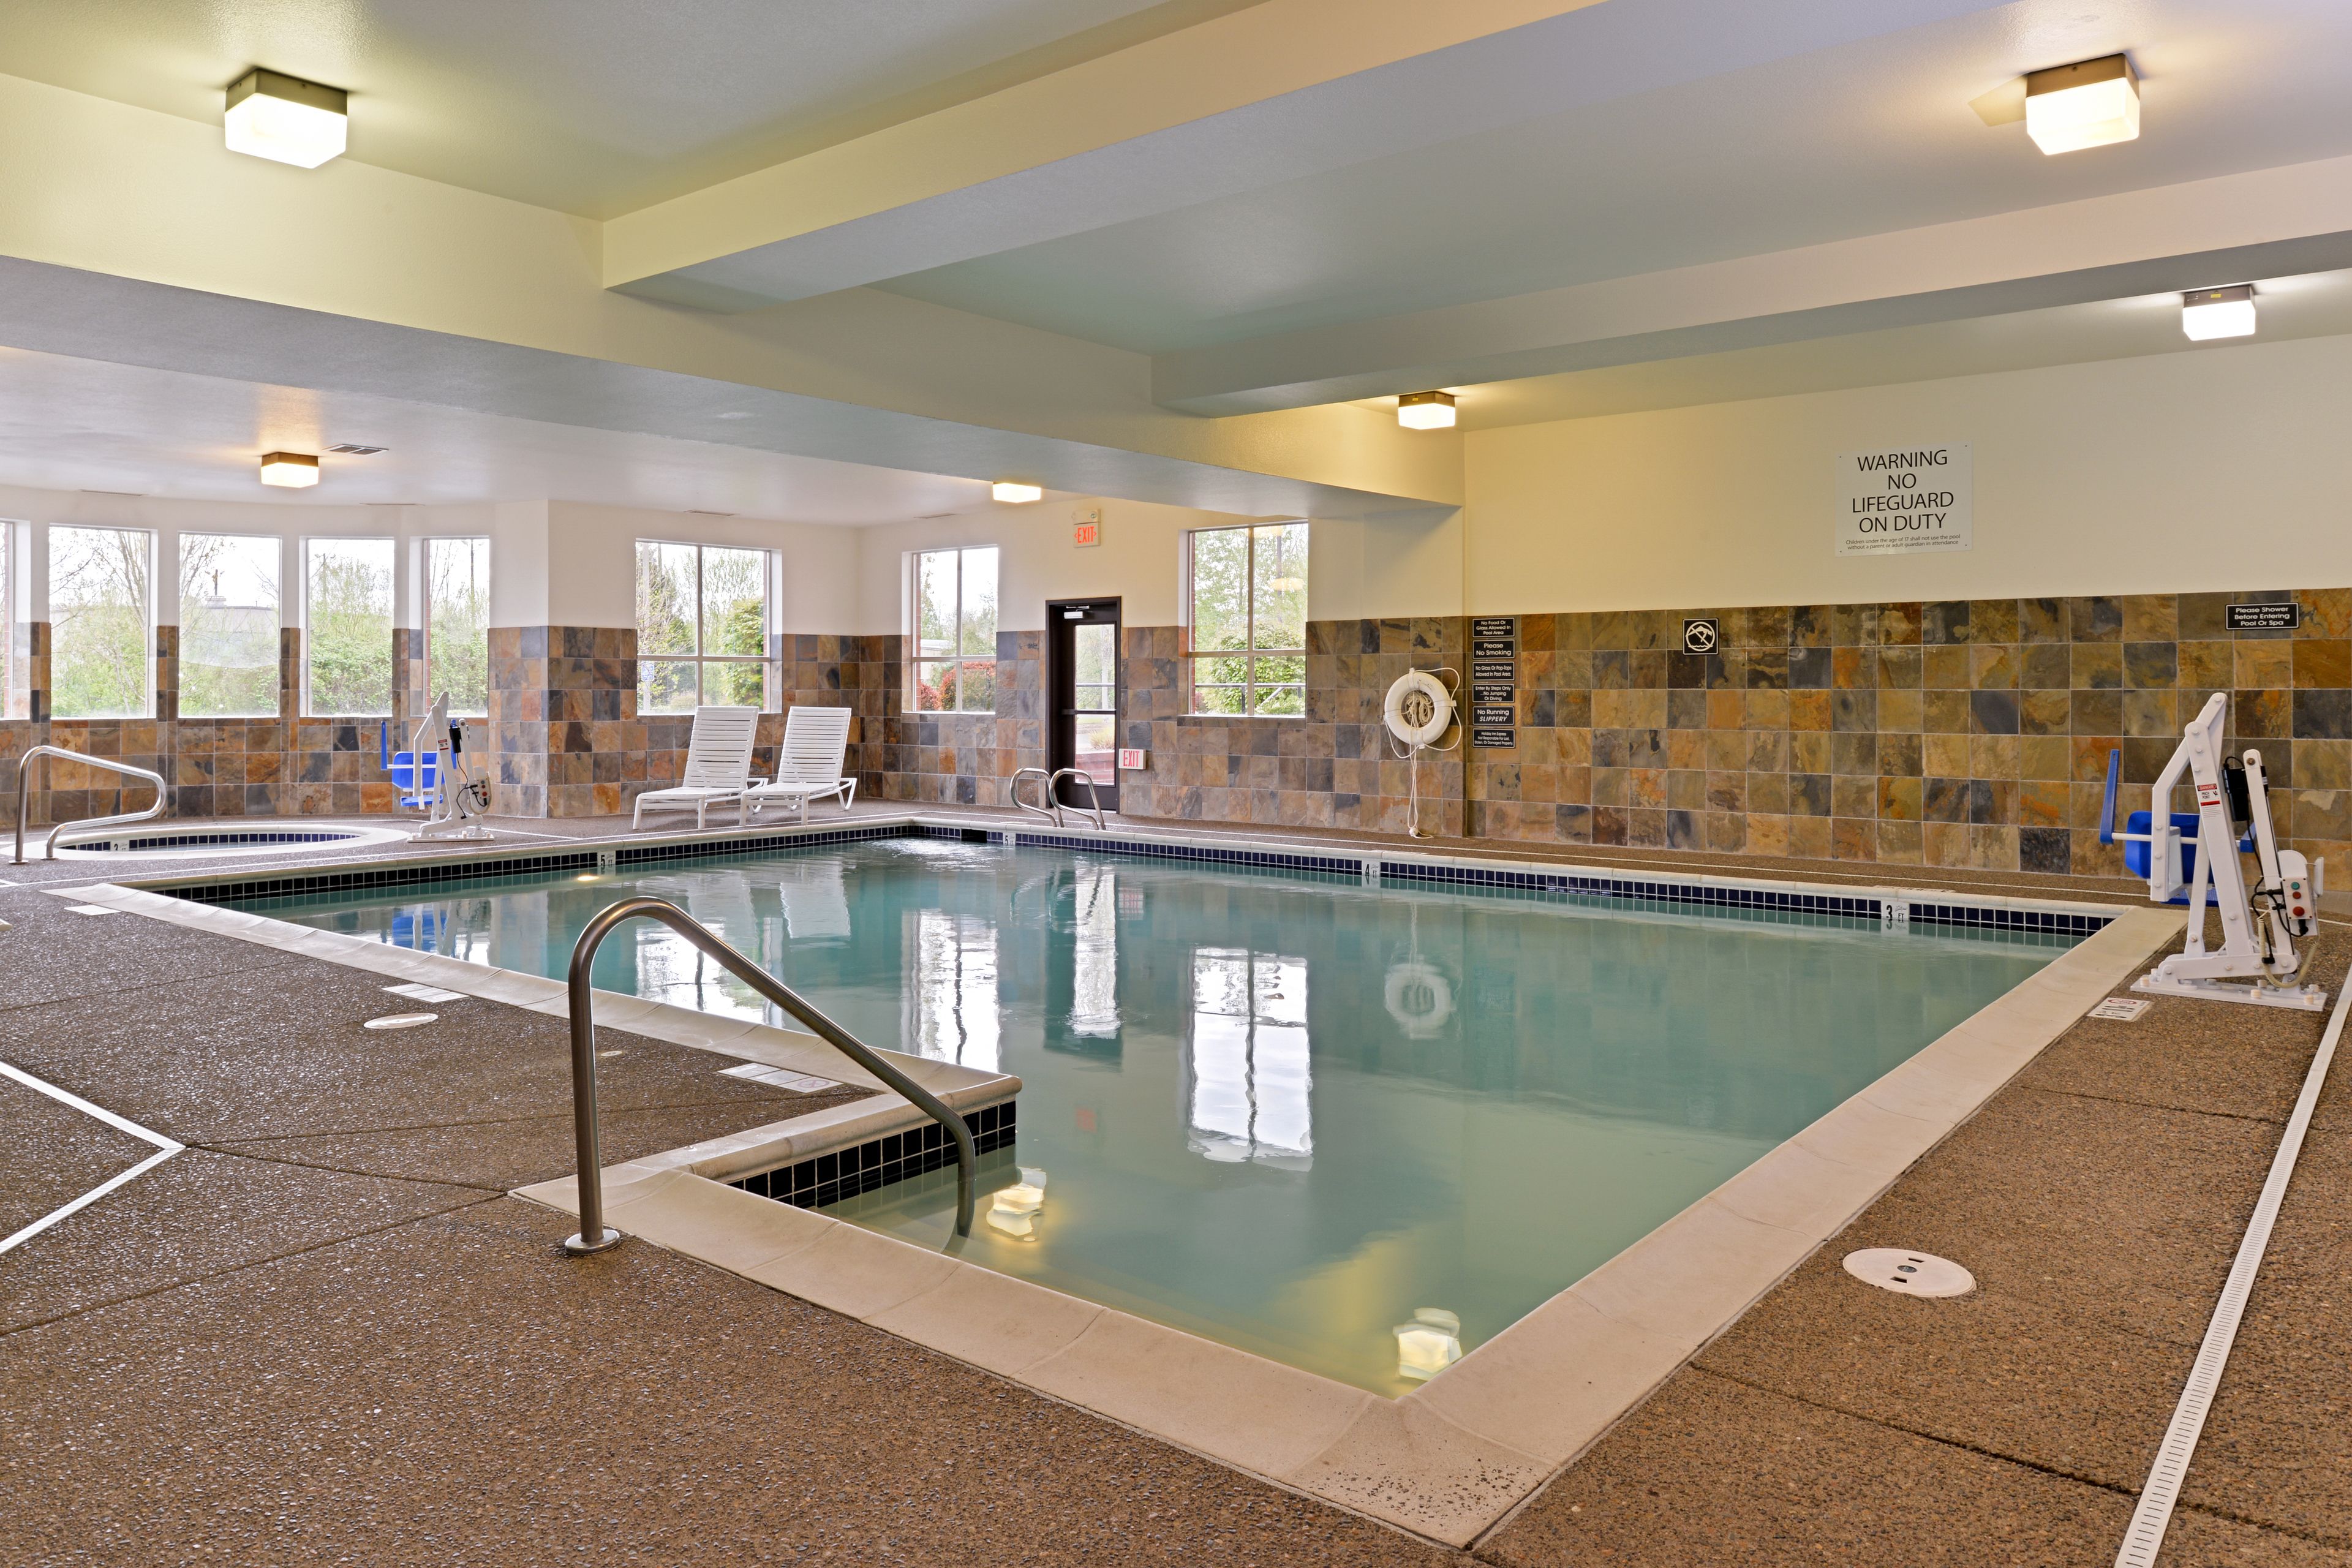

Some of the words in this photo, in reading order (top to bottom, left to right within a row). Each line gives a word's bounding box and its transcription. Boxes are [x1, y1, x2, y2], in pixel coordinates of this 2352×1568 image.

[1857, 450, 1947, 471] WARNING
[1888, 473, 1917, 489] NO
[1852, 492, 1954, 513] LIFEGUARD
[1859, 516, 1887, 533] ON
[1894, 513, 1947, 531] DUTY
[1077, 526, 1095, 543] EXIT
[1123, 750, 1139, 767] EXIT
[1005, 835, 1008, 845] 5
[601, 854, 605, 866] 5
[1365, 864, 1370, 874] 4
[1887, 904, 1893, 921] 3
[1898, 913, 1904, 921] FT
